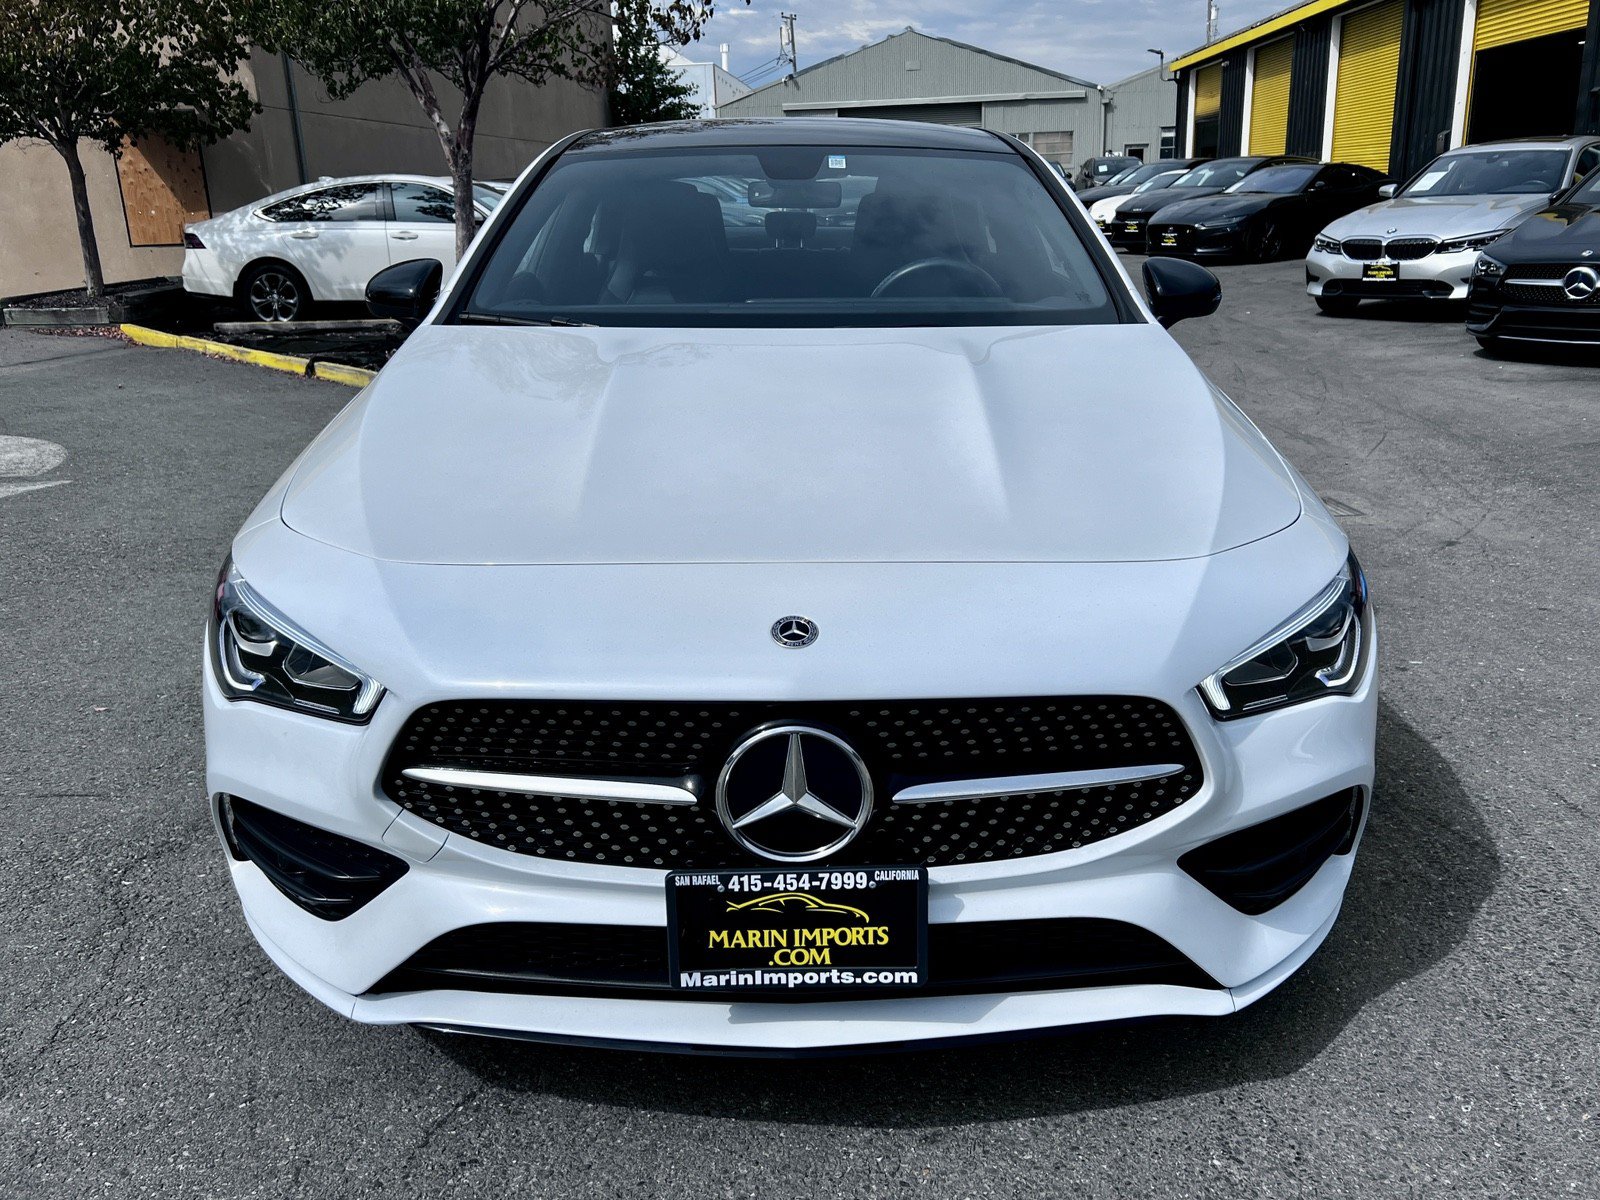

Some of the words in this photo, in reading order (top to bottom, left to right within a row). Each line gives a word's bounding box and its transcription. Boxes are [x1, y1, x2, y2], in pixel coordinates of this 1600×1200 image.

[675, 875, 690, 886] SAN
[692, 875, 720, 885] RAFAEL
[728, 872, 867, 892] 415-454-7999
[874, 870, 919, 881] CALIFORNIA
[708, 929, 787, 948] MARIN
[793, 926, 889, 946] IMPORTS
[768, 948, 832, 966] .COM
[680, 969, 918, 988] MarinImports.com
